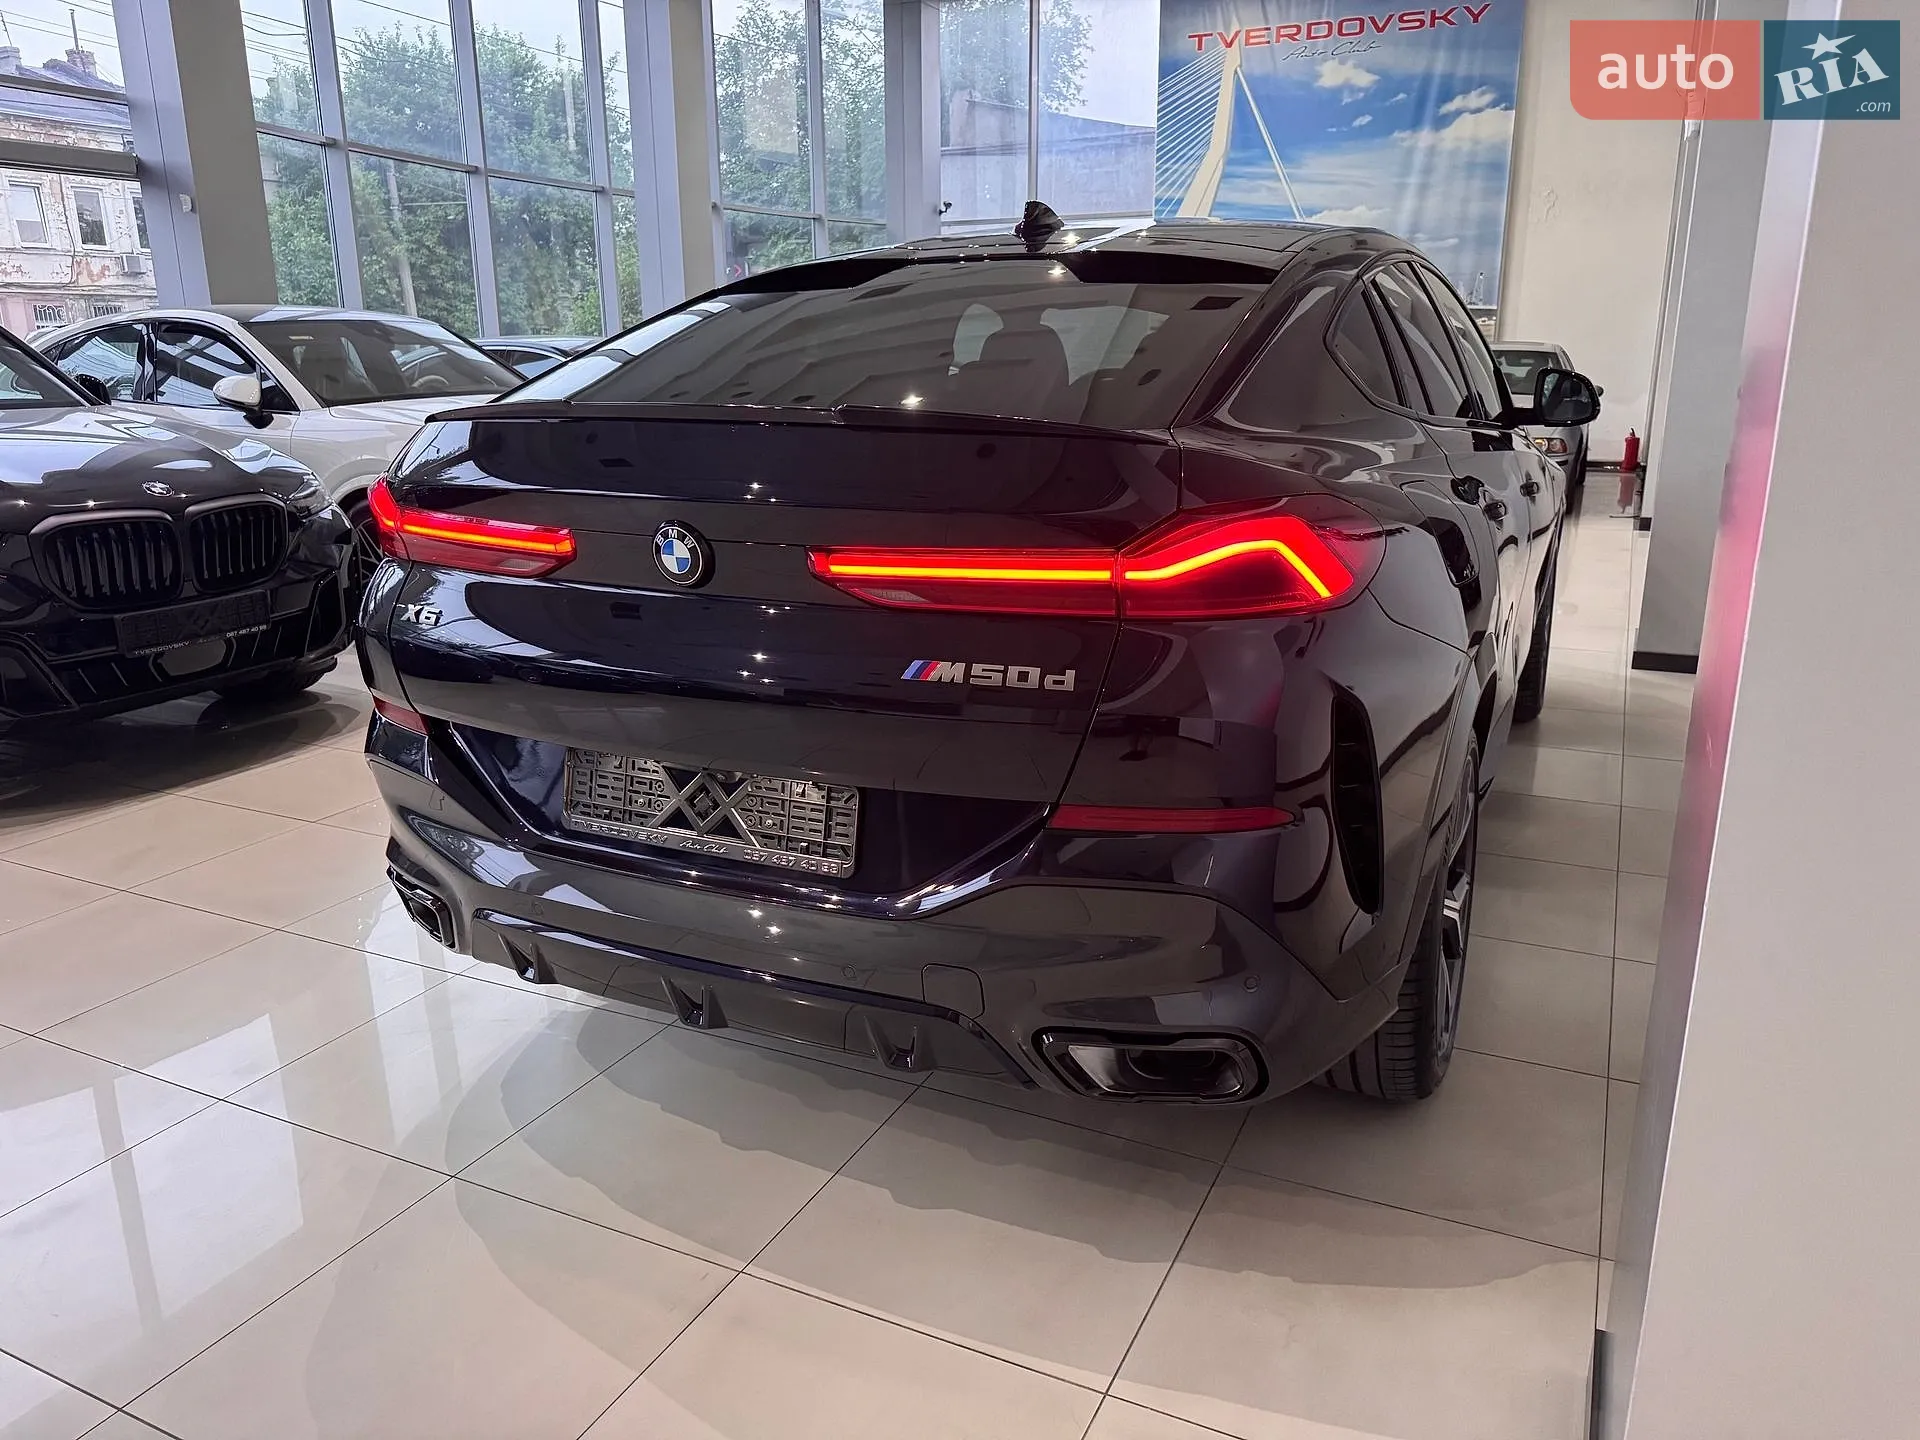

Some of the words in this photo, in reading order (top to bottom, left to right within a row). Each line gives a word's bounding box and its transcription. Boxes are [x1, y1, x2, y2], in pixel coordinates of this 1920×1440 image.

[1187, 2, 1492, 51] TVERDOVSKY
[1280, 44, 1325, 61] Auto
[1331, 40, 1385, 57] Club
[656, 528, 695, 549] BMW
[400, 603, 442, 626] X6
[926, 660, 1076, 692] M50d
